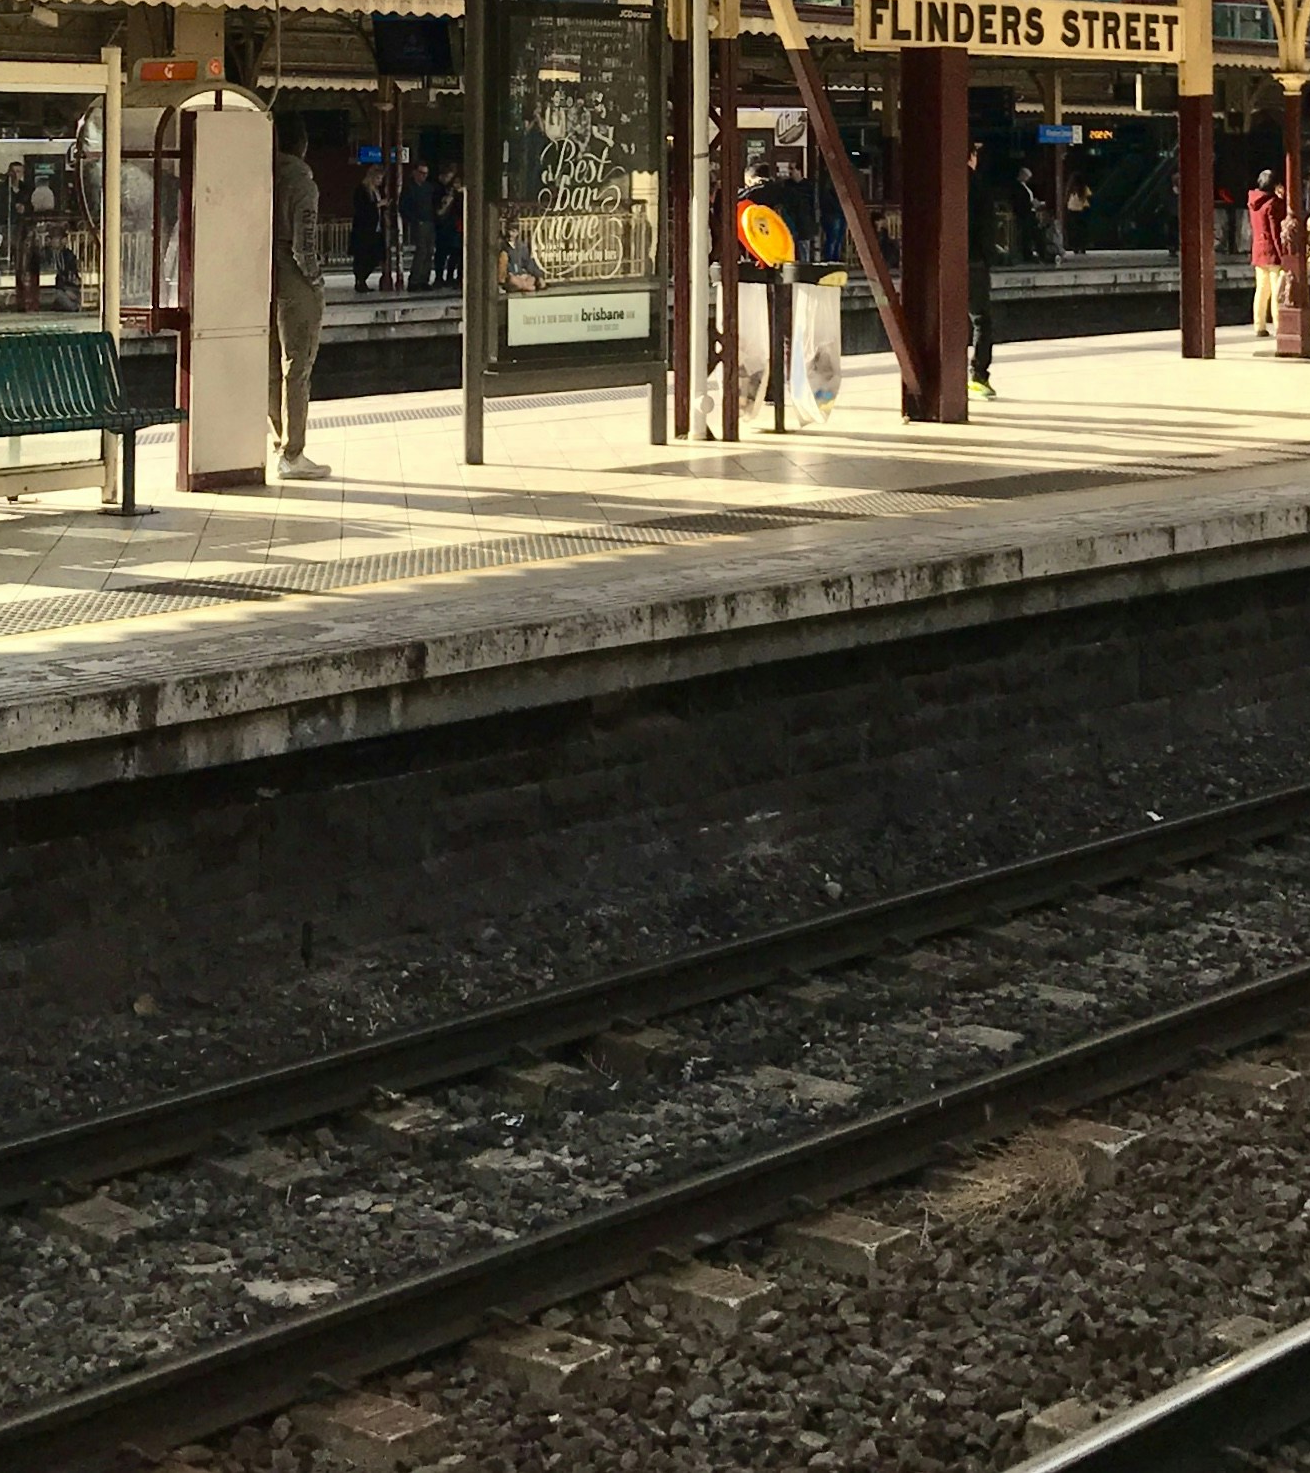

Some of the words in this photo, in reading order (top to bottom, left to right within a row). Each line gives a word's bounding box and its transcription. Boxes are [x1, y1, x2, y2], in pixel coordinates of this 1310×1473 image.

[1060, 8, 1179, 52] STREET
[543, 135, 613, 184] Best
[552, 175, 602, 213] bar
[547, 214, 599, 240] none
[581, 307, 625, 322] brisbane
